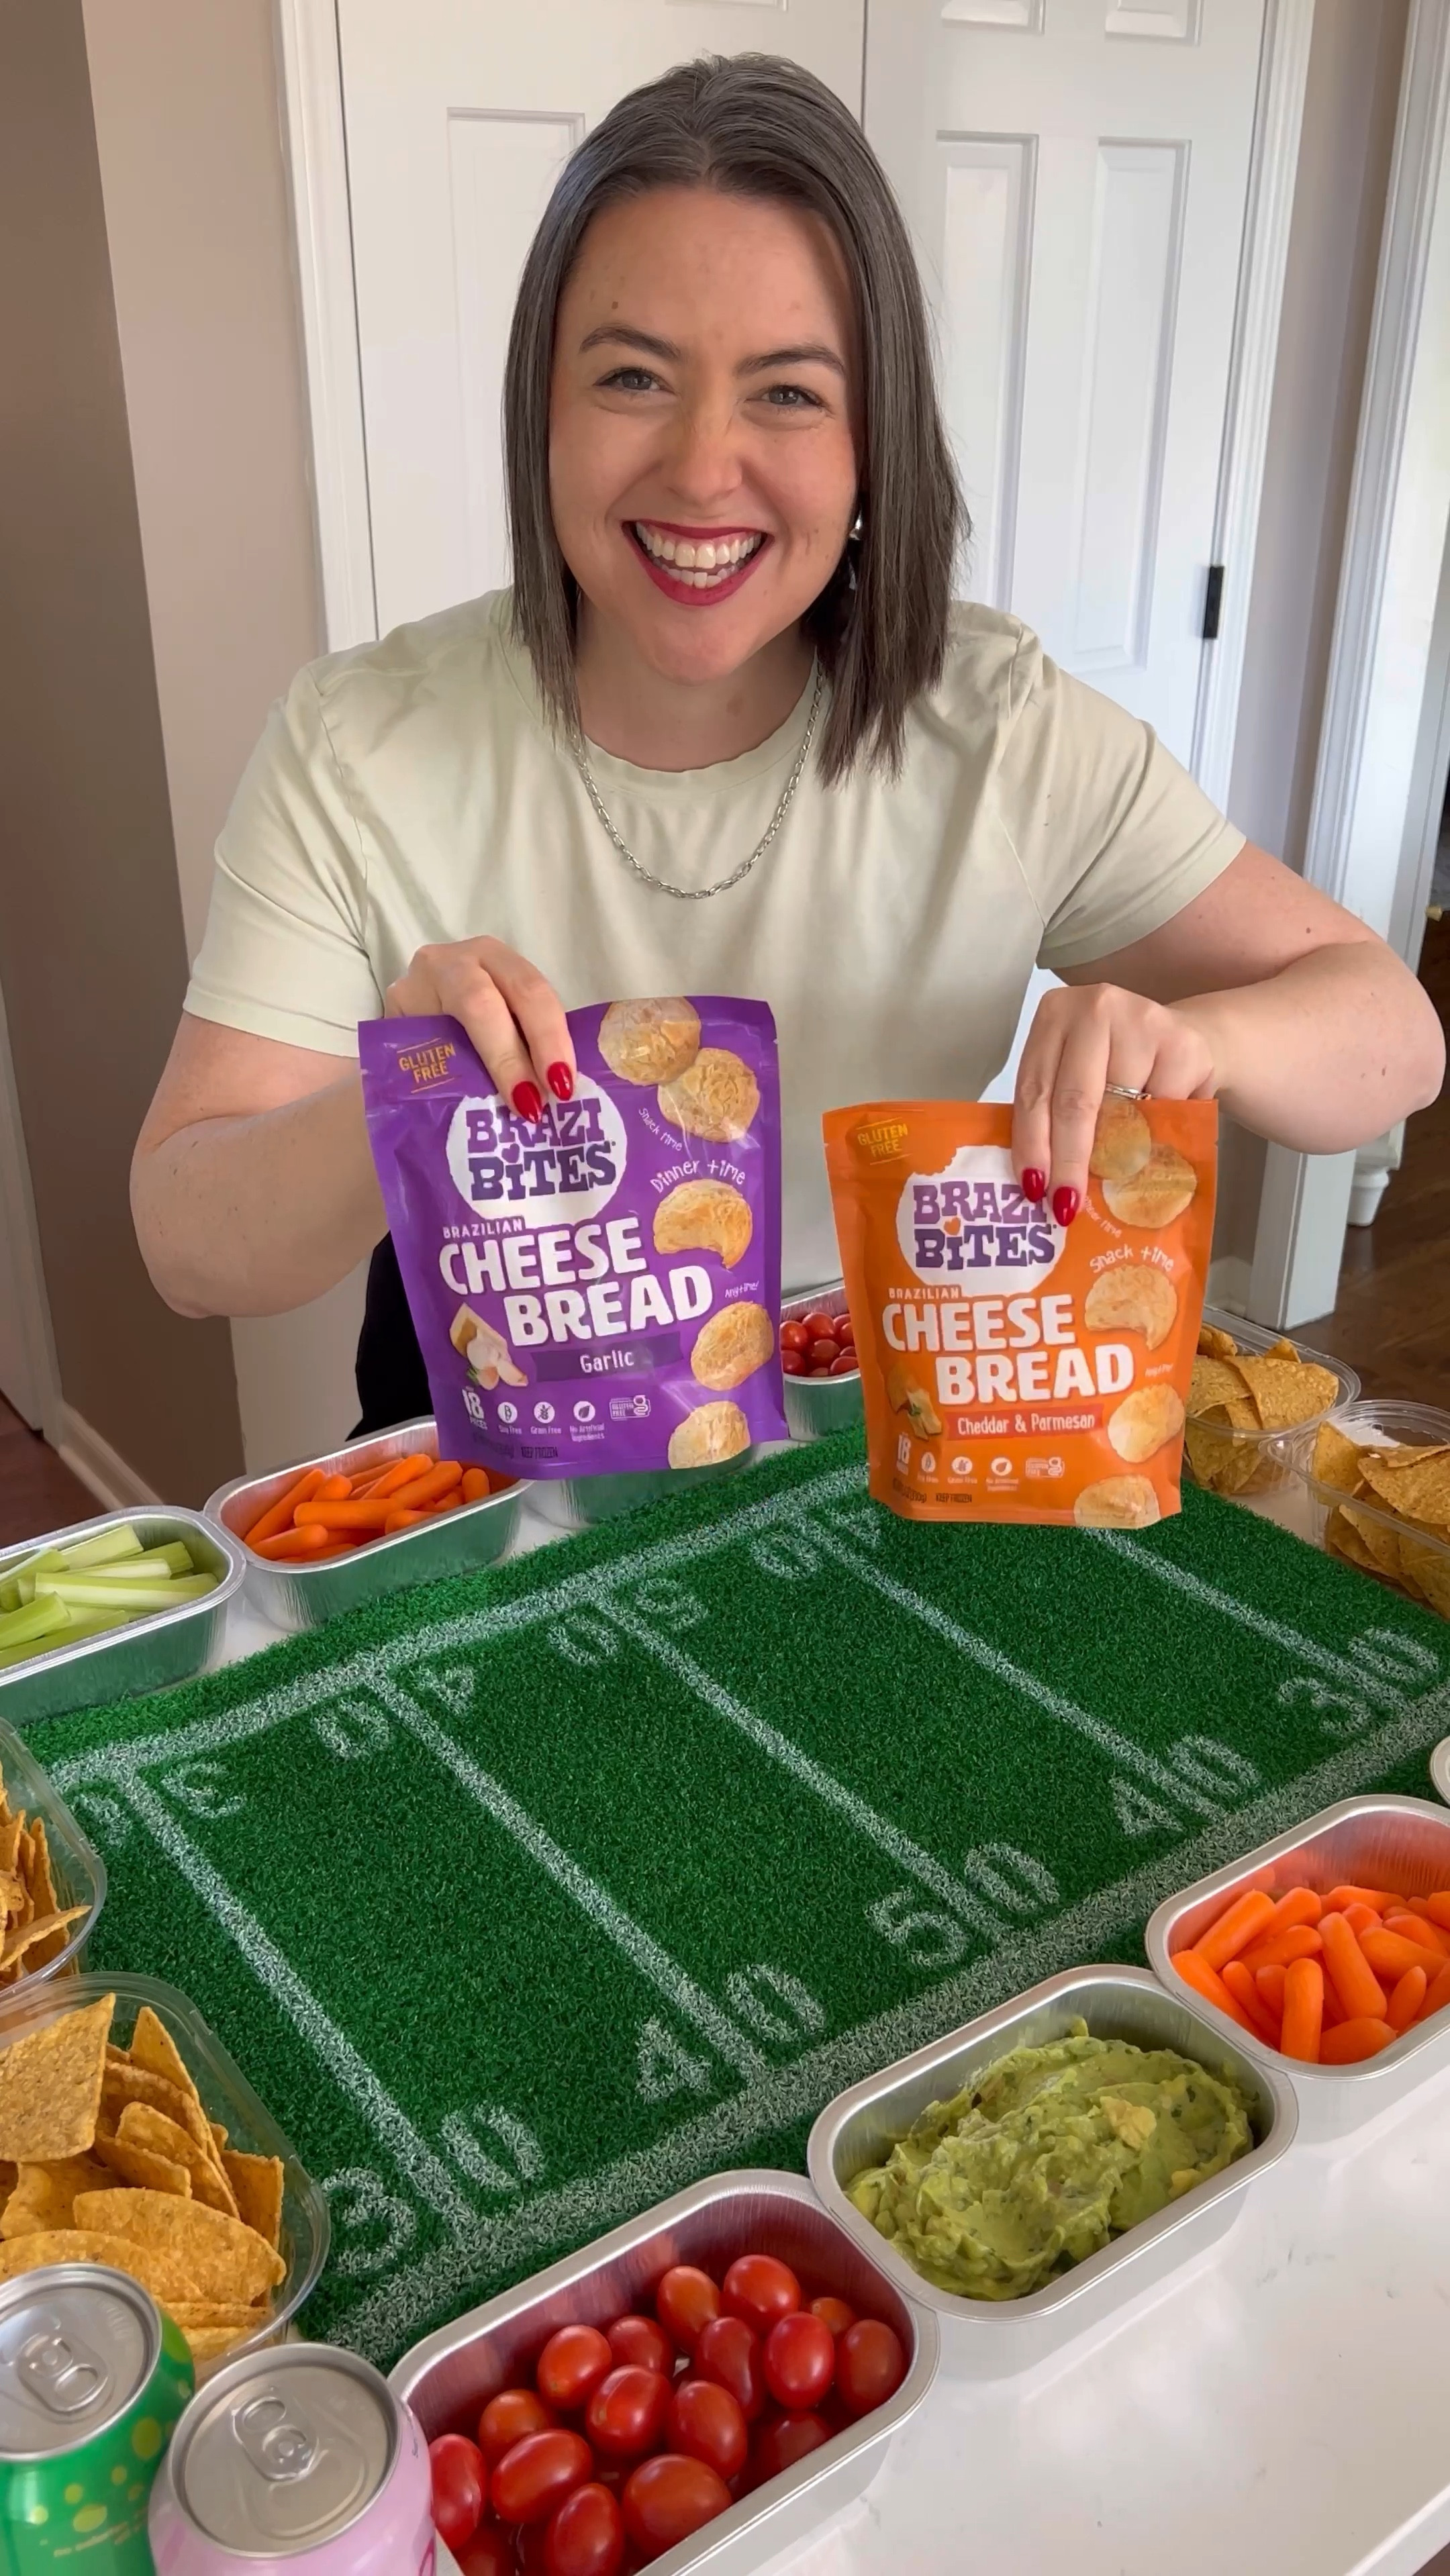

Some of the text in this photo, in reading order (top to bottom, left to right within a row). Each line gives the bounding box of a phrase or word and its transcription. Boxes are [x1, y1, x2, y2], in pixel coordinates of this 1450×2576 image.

[399, 1043, 455, 1072] GLUTEN
[413, 1061, 449, 1083] FREE
[466, 1098, 605, 1153] BRAZI
[857, 1123, 908, 1146] GLUTEN
[870, 1140, 902, 1157] FREE
[650, 1160, 700, 1193] Dinner
[443, 1218, 523, 1239] BRAZILIAN
[439, 1217, 647, 1295] CHEESE
[503, 1266, 713, 1346] BREAD
[888, 1287, 960, 1301] BRAZILIAN
[882, 1294, 1075, 1353] CHEESE
[580, 1350, 635, 1373] Garlic
[936, 1344, 1134, 1405] BREAD
[462, 1389, 484, 1419] 18
[957, 1413, 1096, 1436] Cheddar & Parmesan
